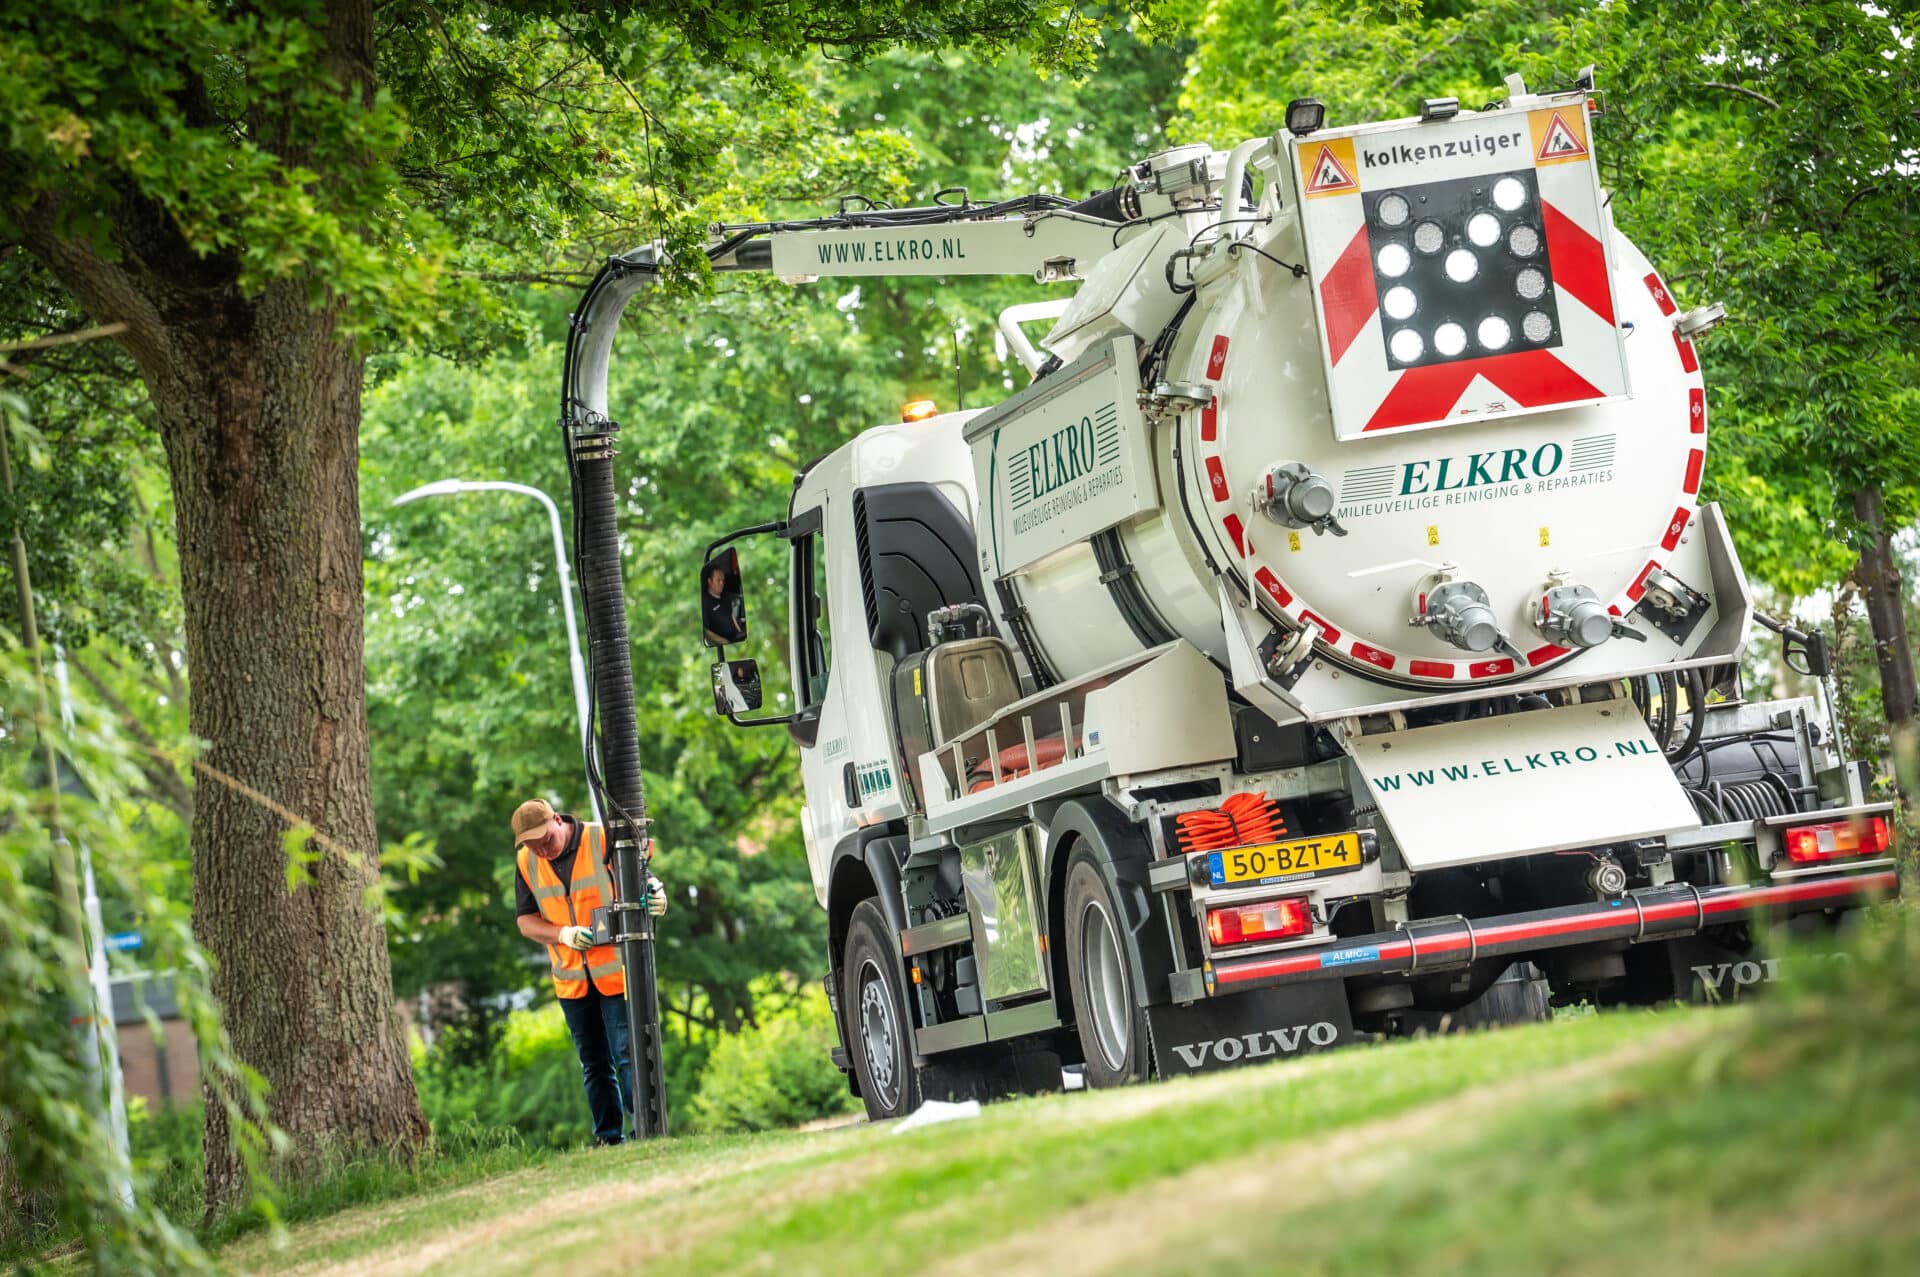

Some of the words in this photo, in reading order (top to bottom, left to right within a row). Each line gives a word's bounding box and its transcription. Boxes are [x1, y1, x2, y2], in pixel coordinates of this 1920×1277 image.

[1363, 132, 1522, 169] kolkenzuiger
[818, 238, 966, 264] WWW.ELKRO.NL
[1029, 416, 1095, 500] ELKRO
[1398, 442, 1563, 496] ELKRO
[1013, 501, 1053, 536] MILIEUVEILIGE
[1052, 485, 1083, 515] REINIGING
[1088, 464, 1123, 497] REPARATIES
[1337, 495, 1440, 519] MILIEUVEILIGE
[1445, 484, 1519, 505] REINIGING
[1523, 482, 1533, 494] &
[1538, 469, 1613, 493] REPARATIES
[1373, 738, 1659, 792] WWW.ELKRO.NL
[1212, 871, 1224, 880] NL
[1233, 839, 1348, 877] 50-BZT-4
[1172, 1021, 1338, 1069] VOLVO
